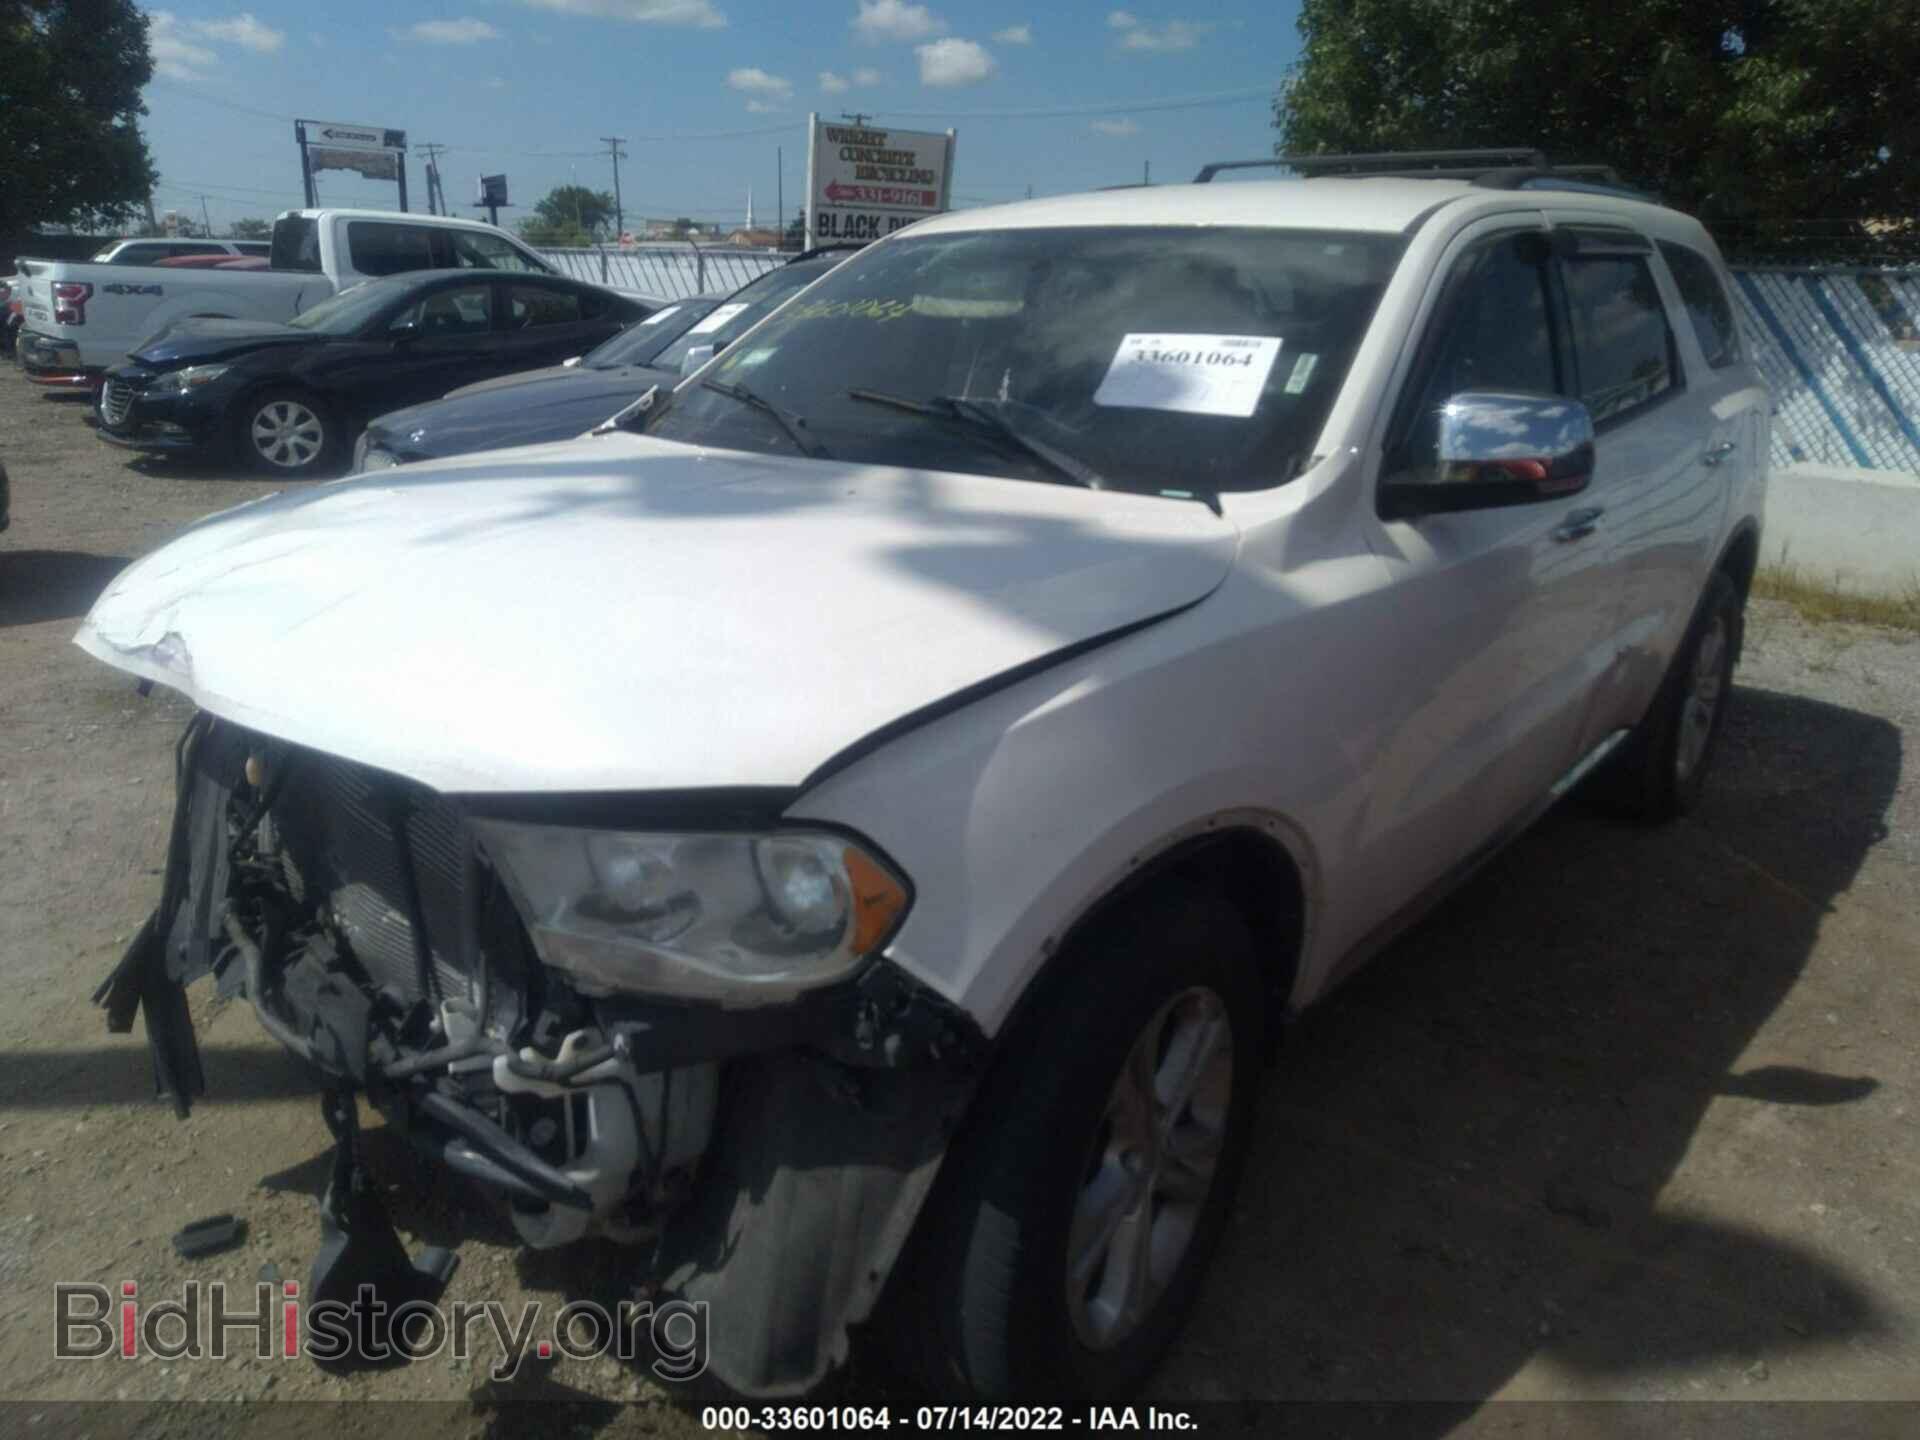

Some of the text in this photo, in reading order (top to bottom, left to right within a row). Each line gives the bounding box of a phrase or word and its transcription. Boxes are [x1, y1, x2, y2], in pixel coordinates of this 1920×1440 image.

[839, 147, 916, 167] CONCRETE
[818, 213, 881, 239] BLACK
[1133, 348, 1254, 367] 33601064
